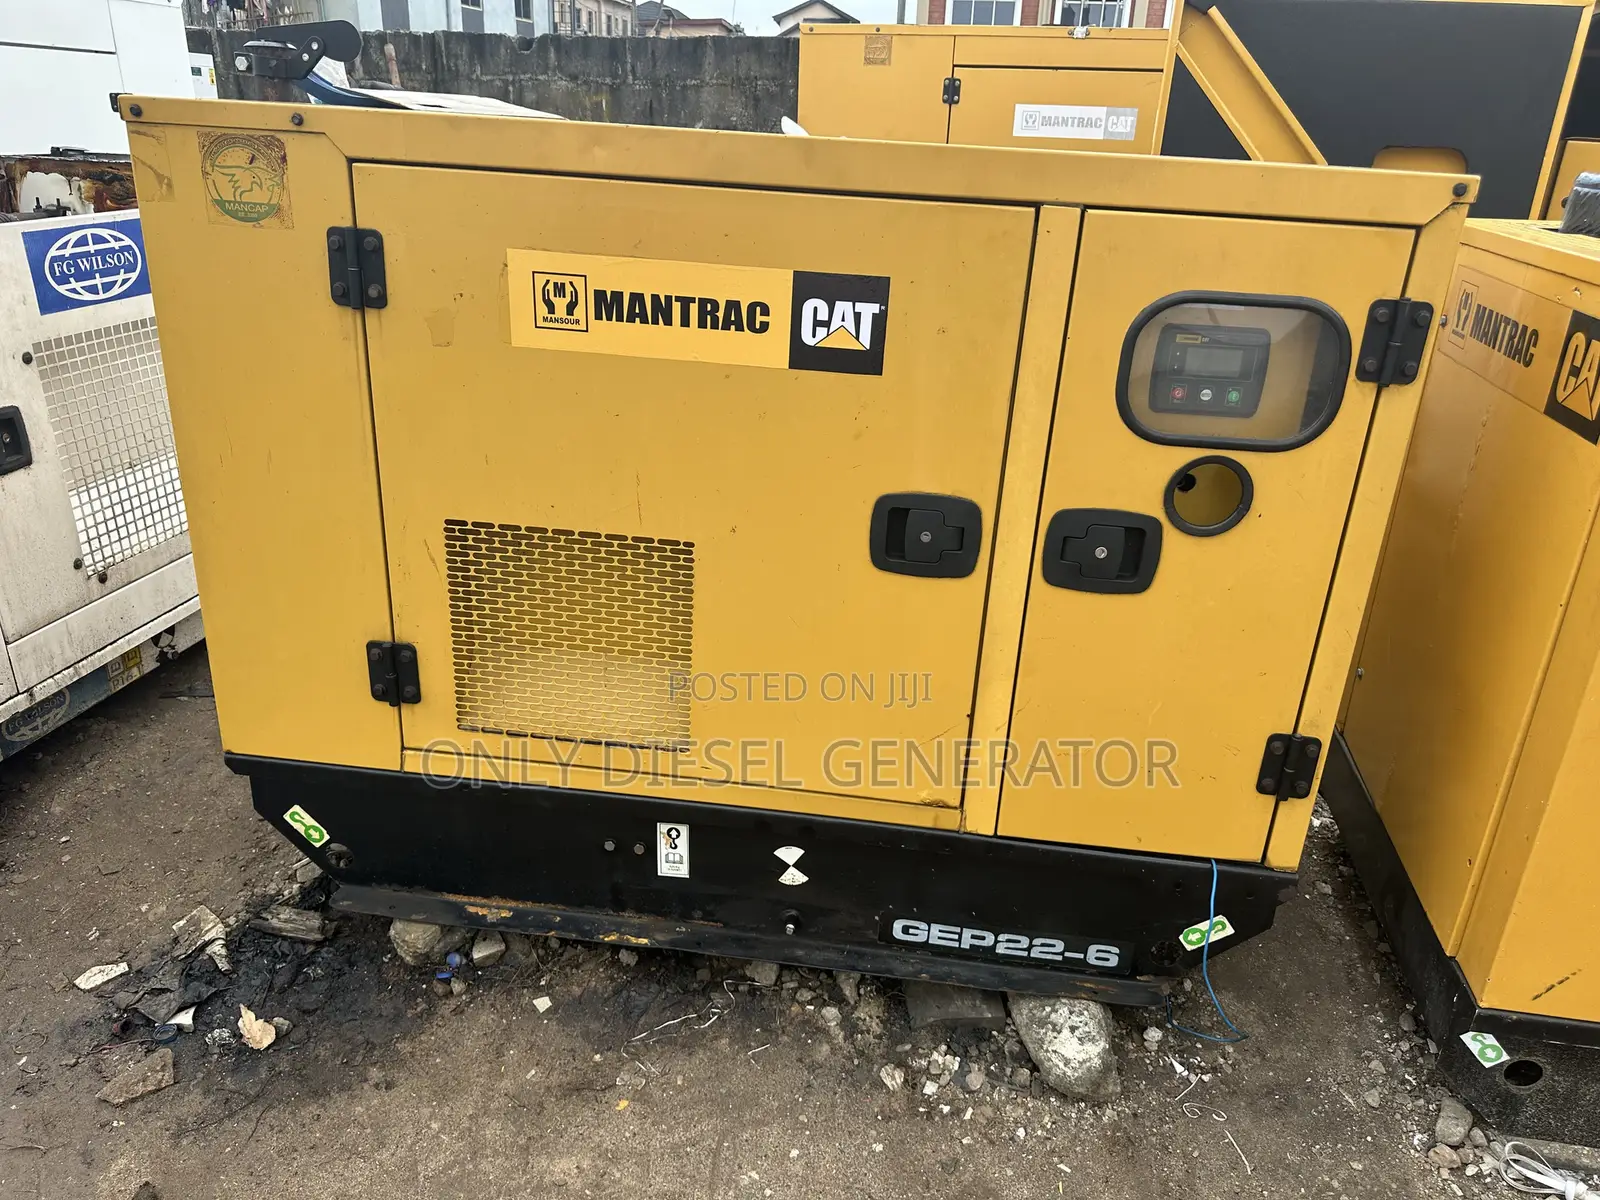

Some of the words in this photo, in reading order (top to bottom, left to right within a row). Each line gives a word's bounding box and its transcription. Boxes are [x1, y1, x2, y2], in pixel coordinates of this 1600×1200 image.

[1041, 115, 1103, 129] MANTRAC
[1107, 115, 1135, 132] CAT
[225, 202, 269, 213] MANCAP
[53, 260, 75, 277] FG
[76, 251, 134, 272] WILSON
[553, 282, 566, 298] M
[542, 316, 580, 326] MANSOUR
[593, 289, 770, 334] MANTRAC
[801, 298, 881, 350] CAT
[1469, 303, 1539, 368] MANTRAC
[1556, 331, 1600, 421] CA
[892, 918, 1120, 967] GEP22-6
